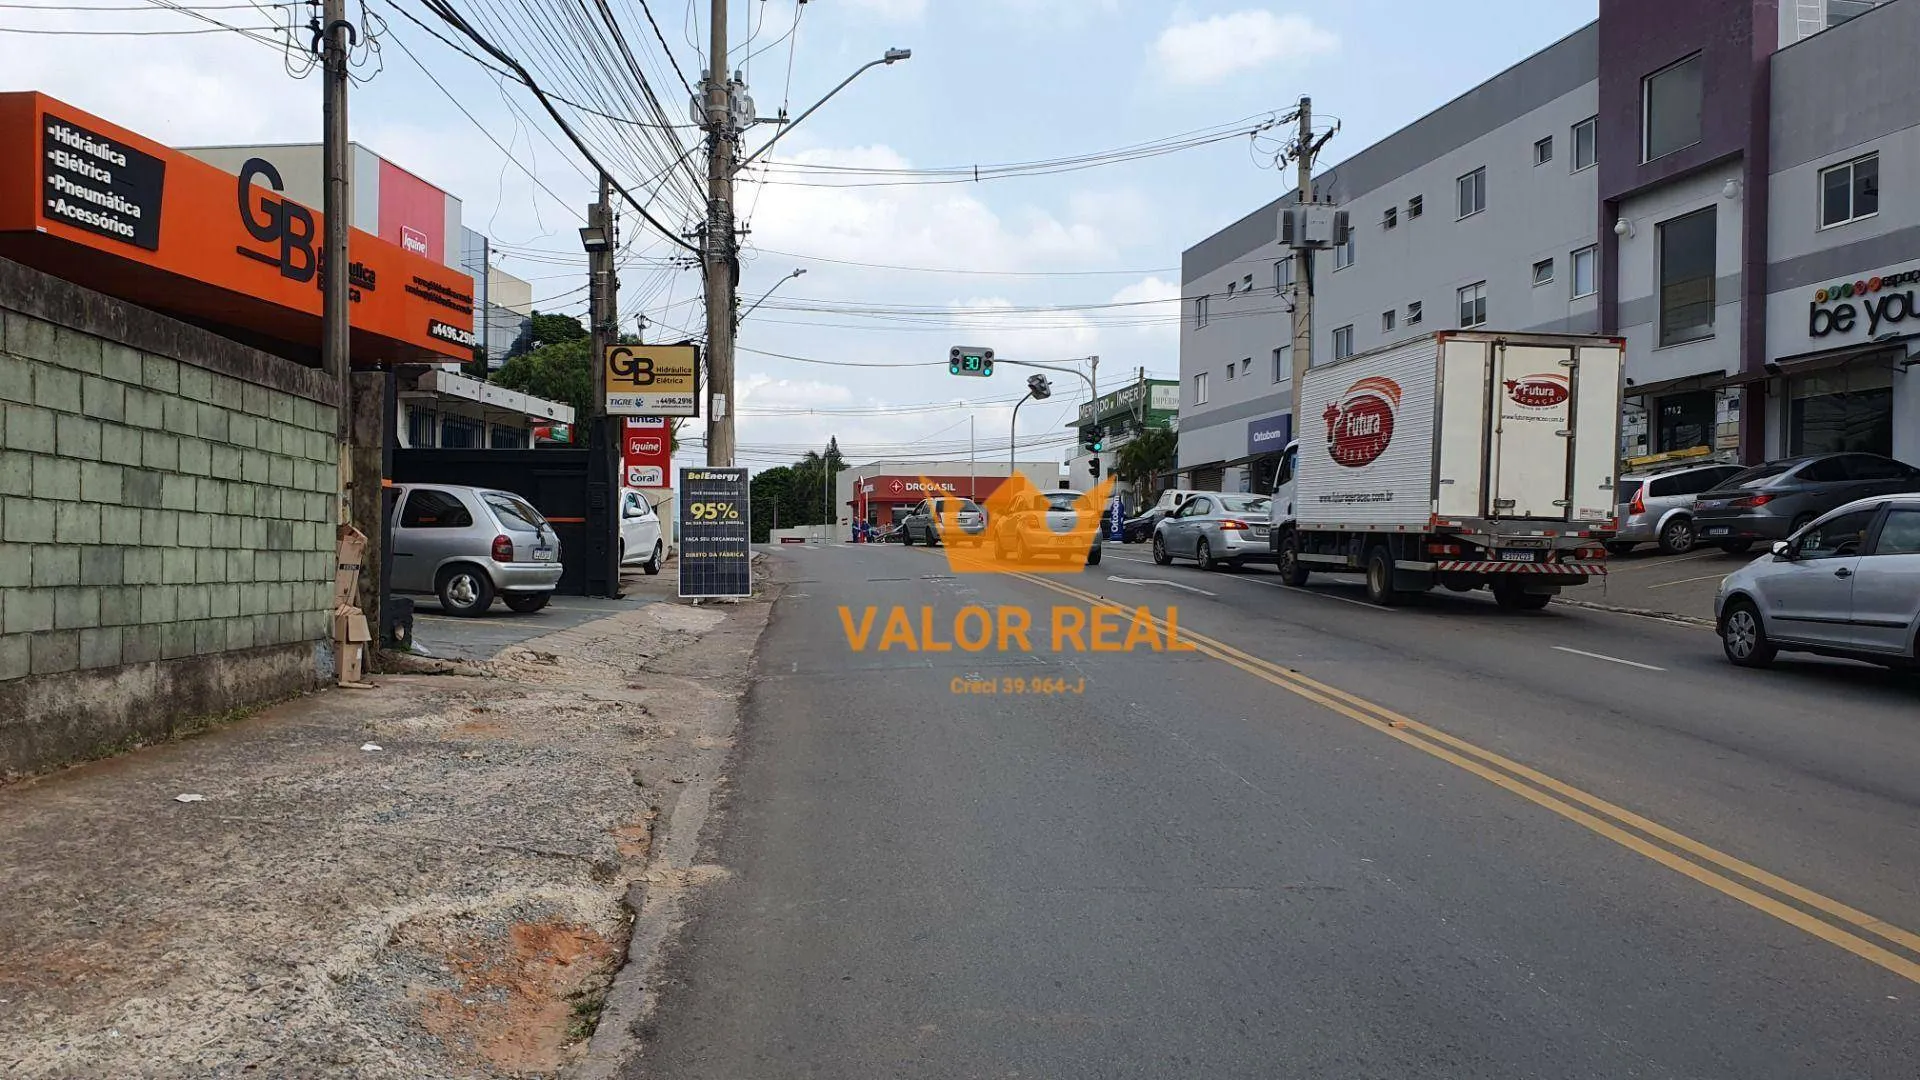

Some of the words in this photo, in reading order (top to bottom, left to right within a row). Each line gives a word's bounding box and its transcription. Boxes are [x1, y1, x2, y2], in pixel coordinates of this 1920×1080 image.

[54, 125, 126, 167] Hidráulica
[54, 149, 112, 184] Elétrica
[54, 174, 141, 218] Pneumática
[54, 198, 134, 237] Acessórios
[238, 157, 316, 283] GB
[1809, 301, 1857, 337] be
[609, 347, 656, 385] GB
[965, 356, 979, 370] 30
[1522, 384, 1555, 397] Futura
[610, 398, 633, 406] TIGRE
[1346, 411, 1381, 438] Futura
[631, 442, 660, 454] Iquine
[630, 473, 655, 482] Coral
[687, 471, 741, 482] BelEnergy
[906, 482, 956, 491] DROGASIL
[690, 502, 739, 520] 95%
